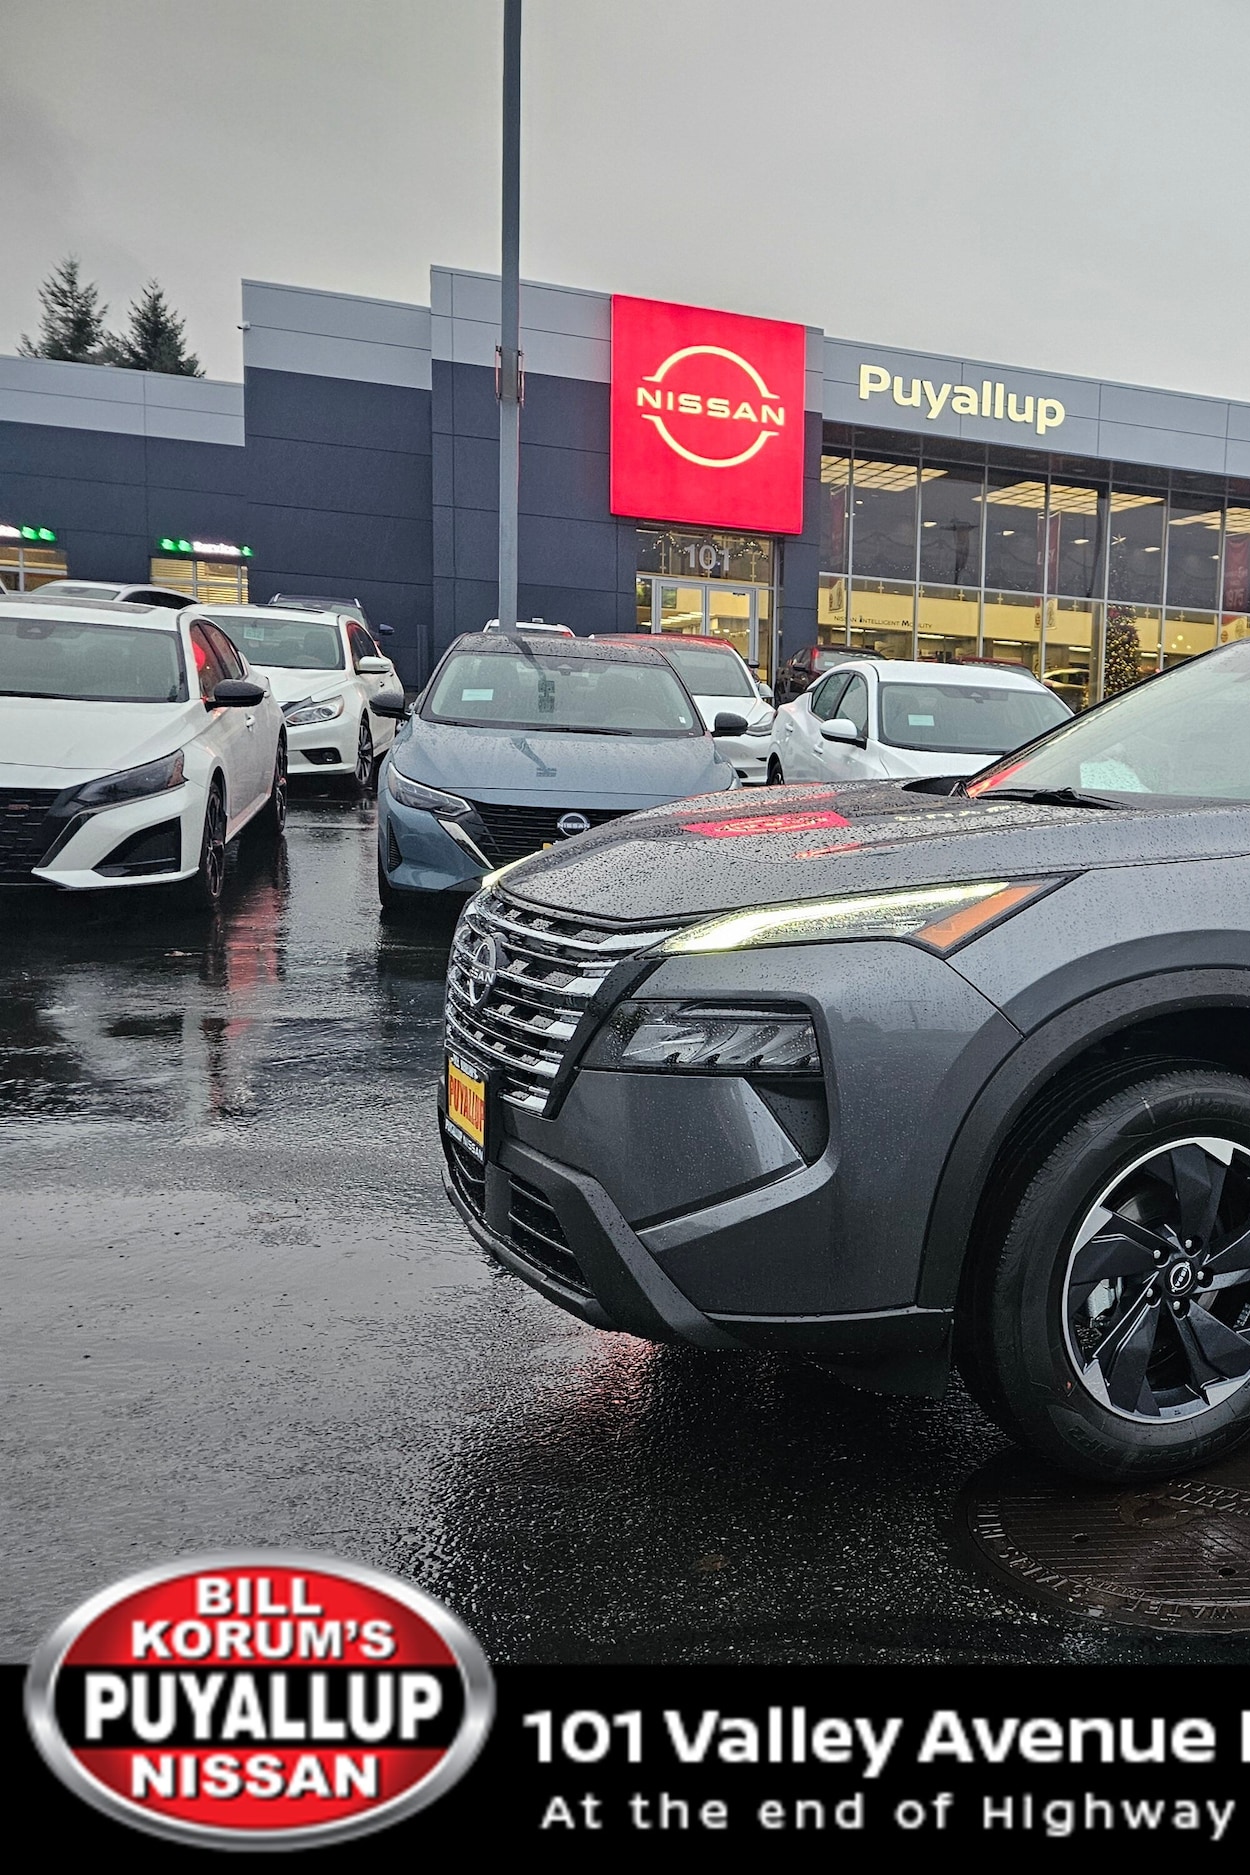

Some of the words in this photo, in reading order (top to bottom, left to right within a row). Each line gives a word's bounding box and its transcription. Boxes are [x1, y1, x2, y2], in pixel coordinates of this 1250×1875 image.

[636, 386, 785, 427] NISSAN
[859, 364, 1065, 435] Puyallup
[683, 544, 730, 572] 101
[834, 615, 857, 624] NISAN
[901, 619, 933, 629] MOLITY
